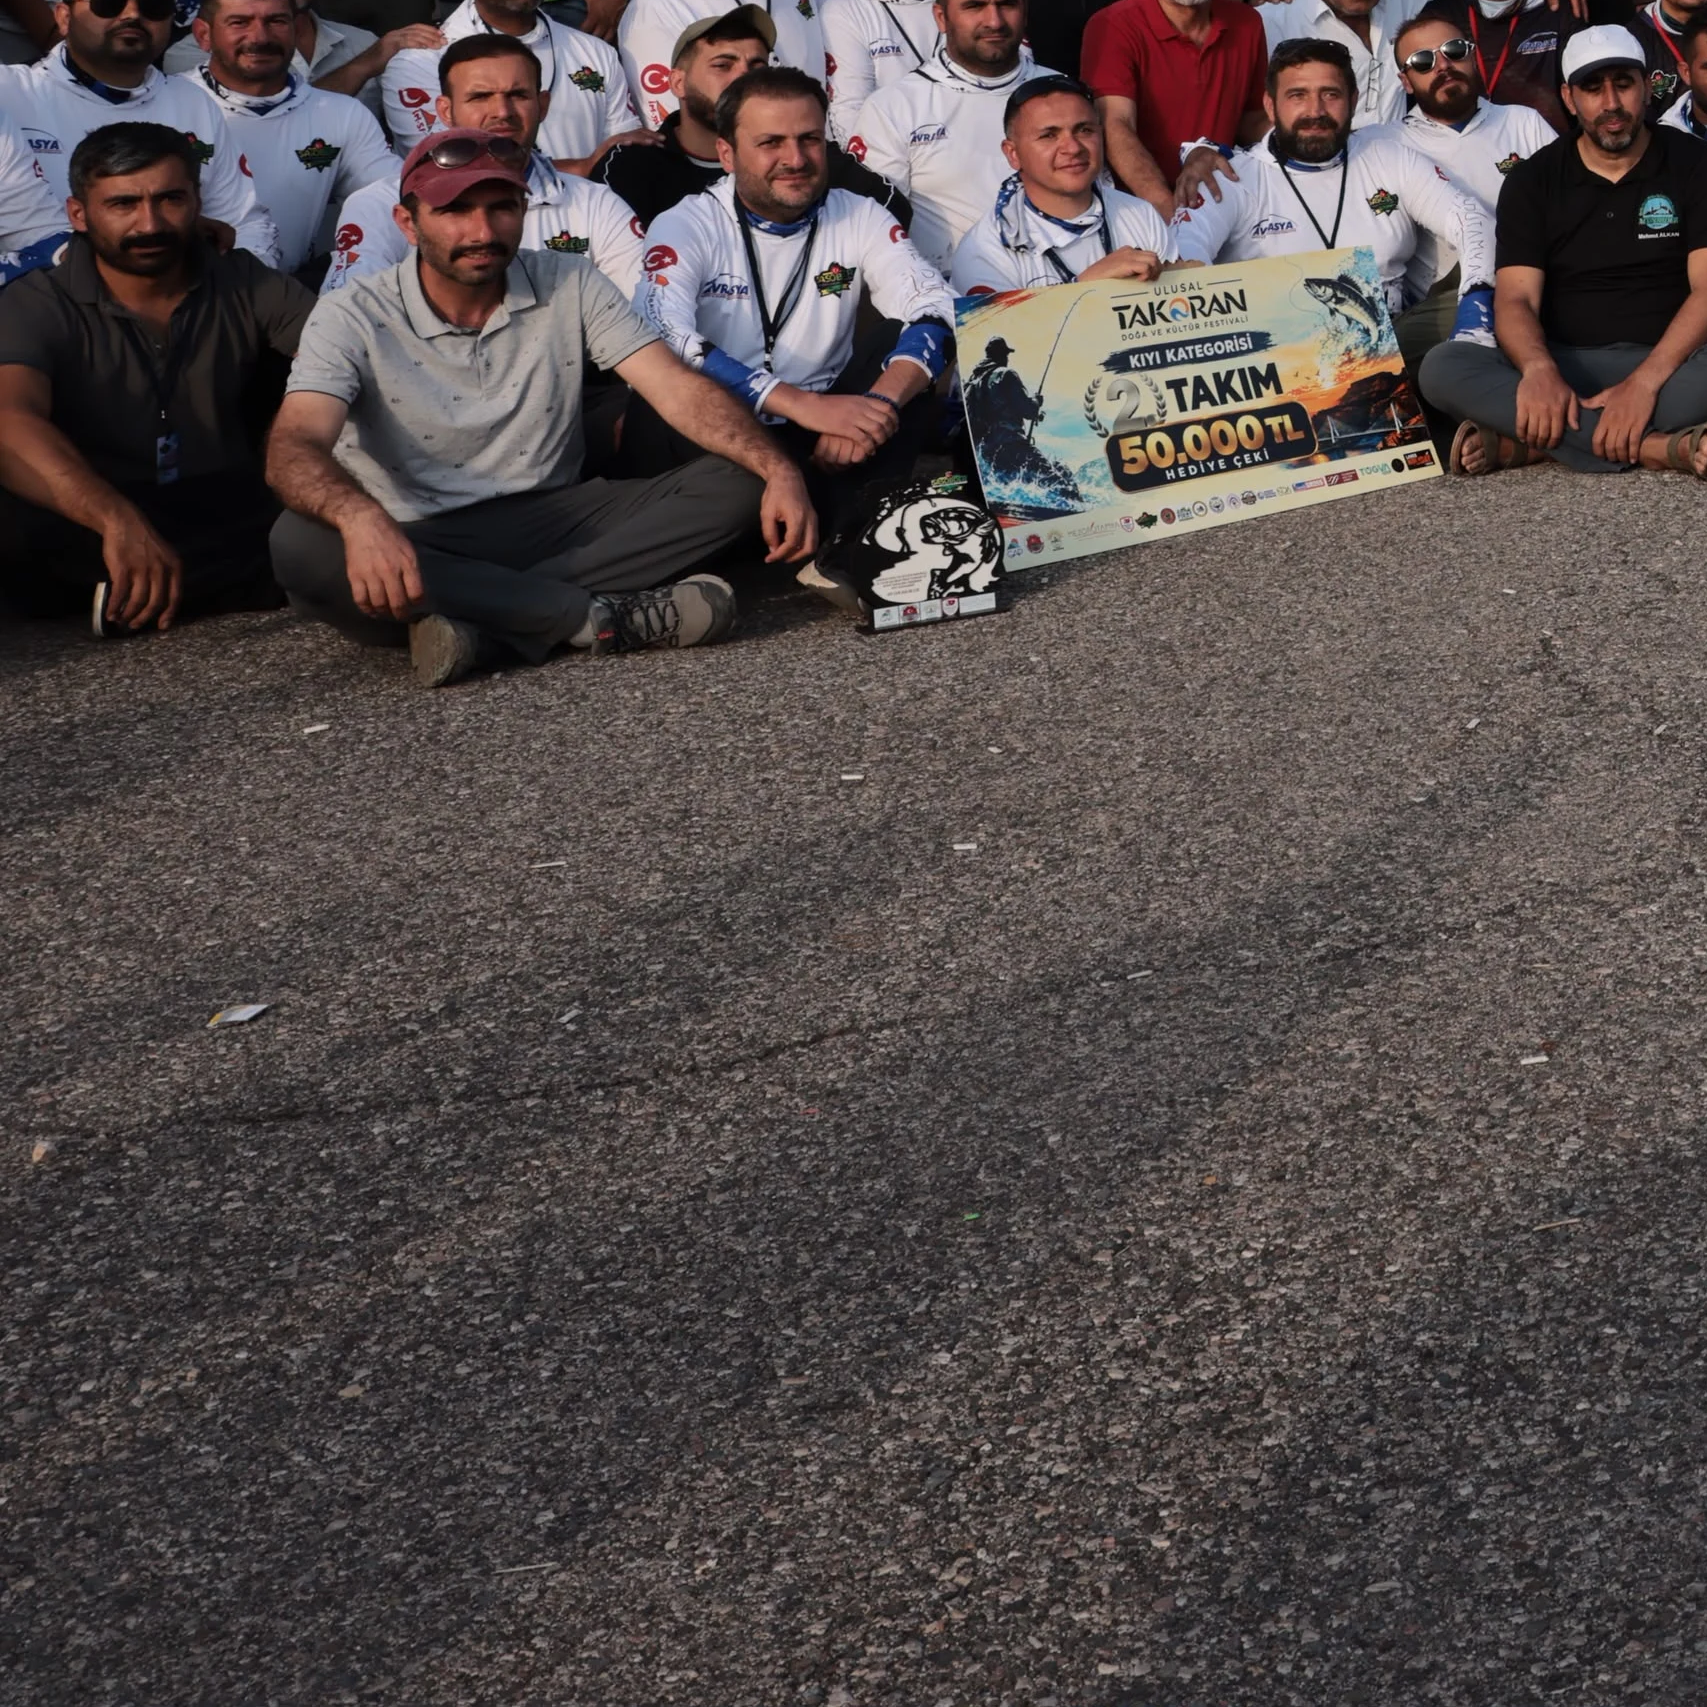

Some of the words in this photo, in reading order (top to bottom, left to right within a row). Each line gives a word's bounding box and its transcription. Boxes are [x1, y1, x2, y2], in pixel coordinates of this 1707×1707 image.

[1154, 281, 1203, 296] ULUSAL
[1111, 289, 1248, 330] TAKORAN
[1121, 331, 1147, 341] DOĞA
[1166, 322, 1200, 335] KÜLTÜR
[1204, 316, 1249, 329] FESTİVALİ
[1129, 351, 1161, 369] KIYI
[1165, 333, 1253, 362] KATEGORİSİ
[1165, 362, 1284, 413] TAKIM
[1118, 414, 1265, 475] 50.000
[1264, 414, 1305, 443] TL
[1165, 455, 1226, 480] HEDİYE
[1233, 447, 1270, 469] ÇEKİ
